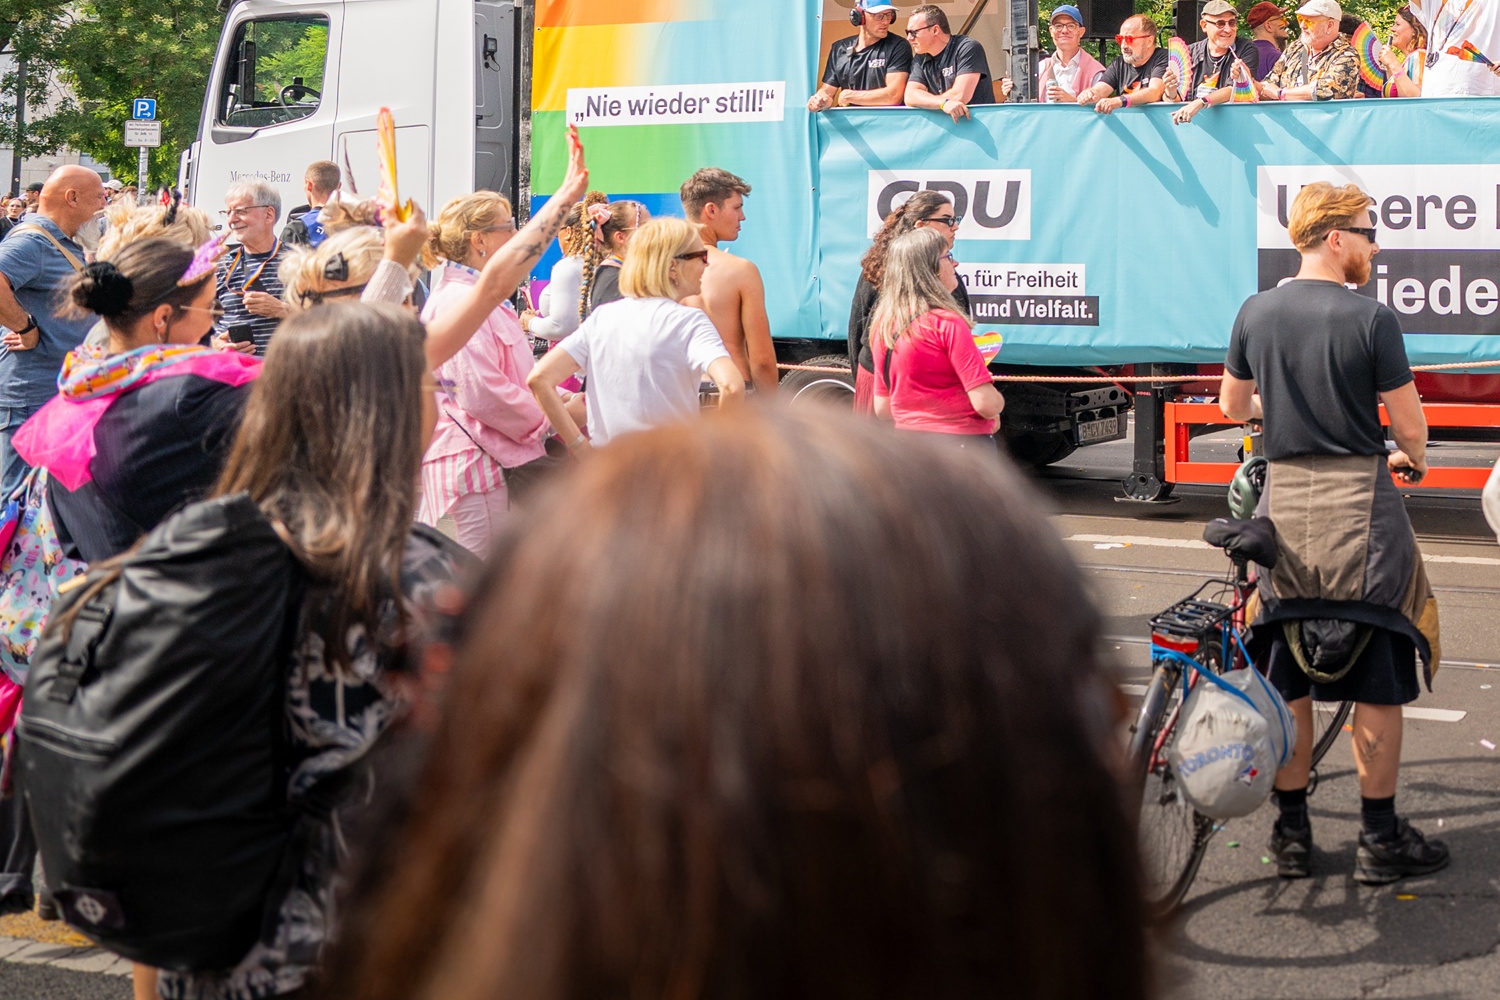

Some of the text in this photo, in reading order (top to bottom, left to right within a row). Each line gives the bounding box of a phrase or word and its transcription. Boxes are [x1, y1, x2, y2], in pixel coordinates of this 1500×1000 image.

[137, 101, 150, 117] P
[627, 91, 710, 117] wieder
[974, 269, 1002, 288] für
[1006, 269, 1079, 288] Freiheit
[975, 299, 1011, 318] und
[1015, 299, 1094, 319] Vielfalt.
[1177, 743, 1255, 778] TORONTO
